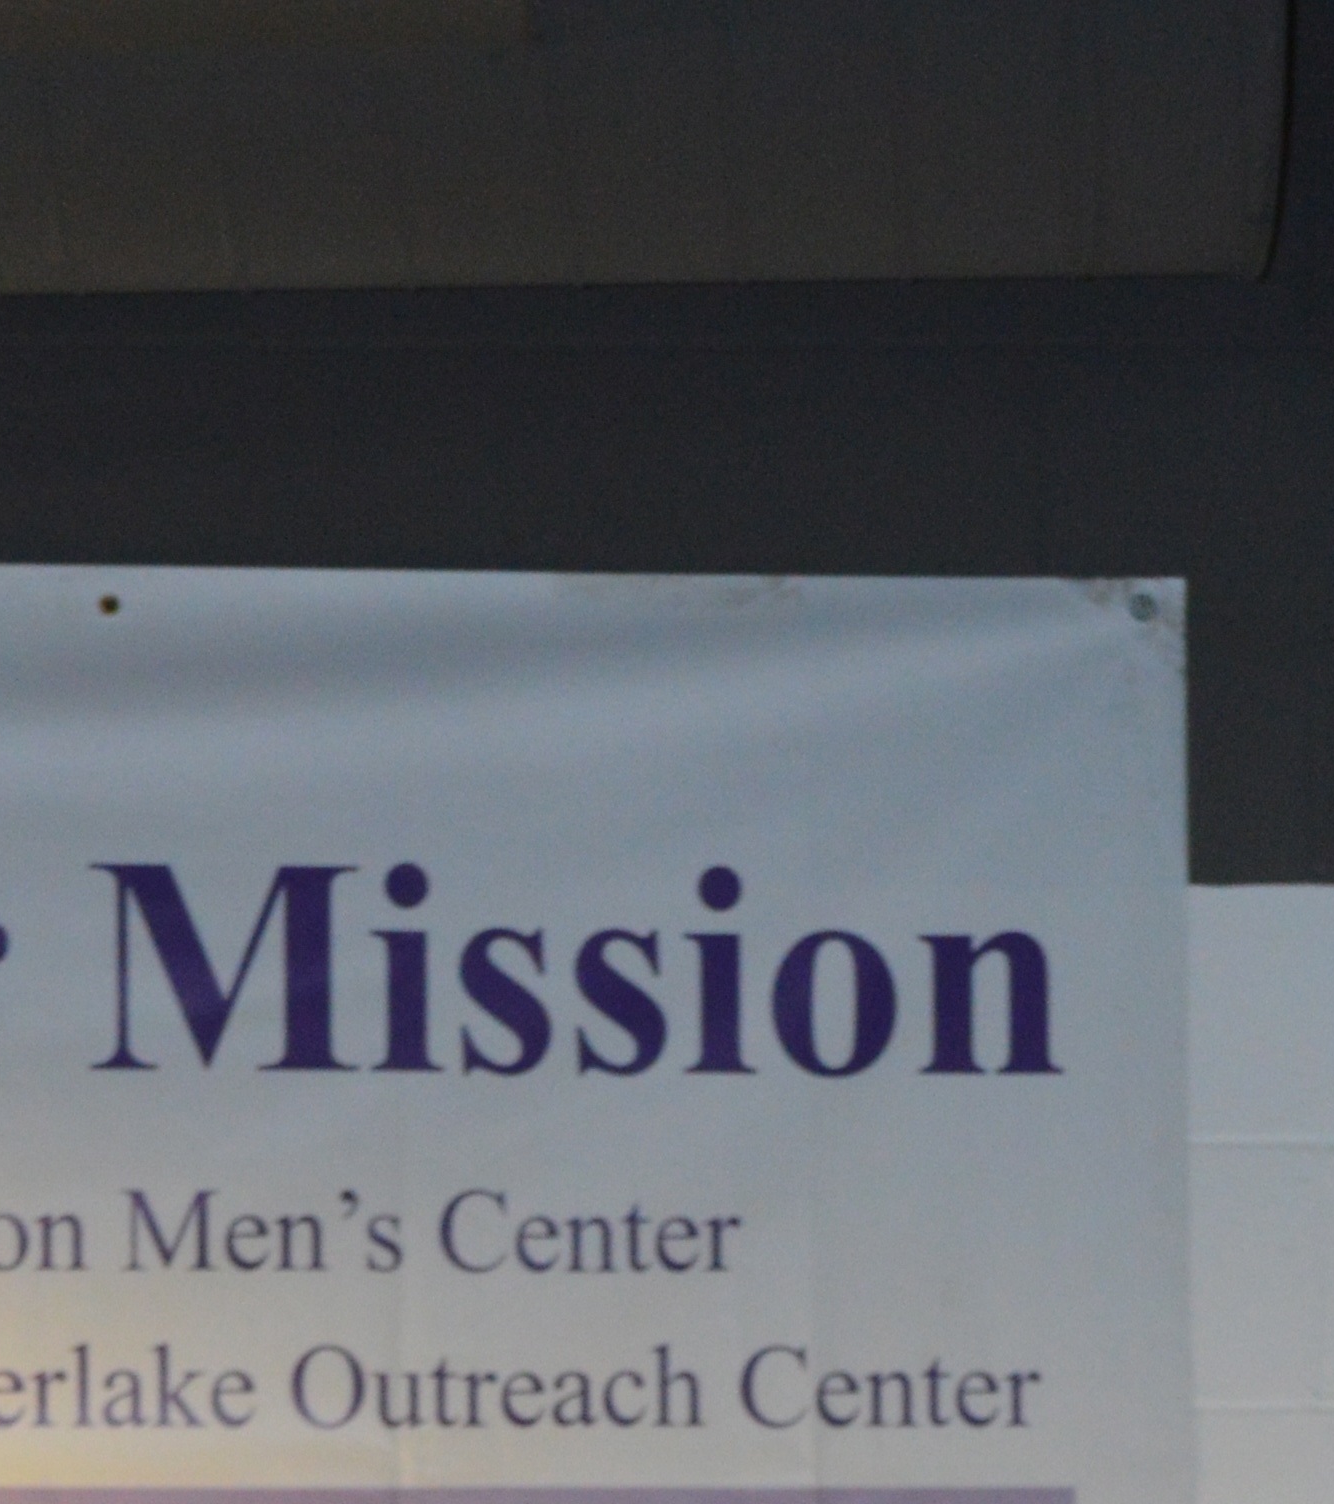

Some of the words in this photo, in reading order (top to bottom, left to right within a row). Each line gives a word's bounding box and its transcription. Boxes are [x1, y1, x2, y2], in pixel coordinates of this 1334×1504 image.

[87, 861, 1065, 1077] Mission
[120, 1188, 405, 1274] Men's
[438, 1189, 743, 1275] Center
[290, 1342, 707, 1430] Outreach
[738, 1343, 1042, 1430] Center
